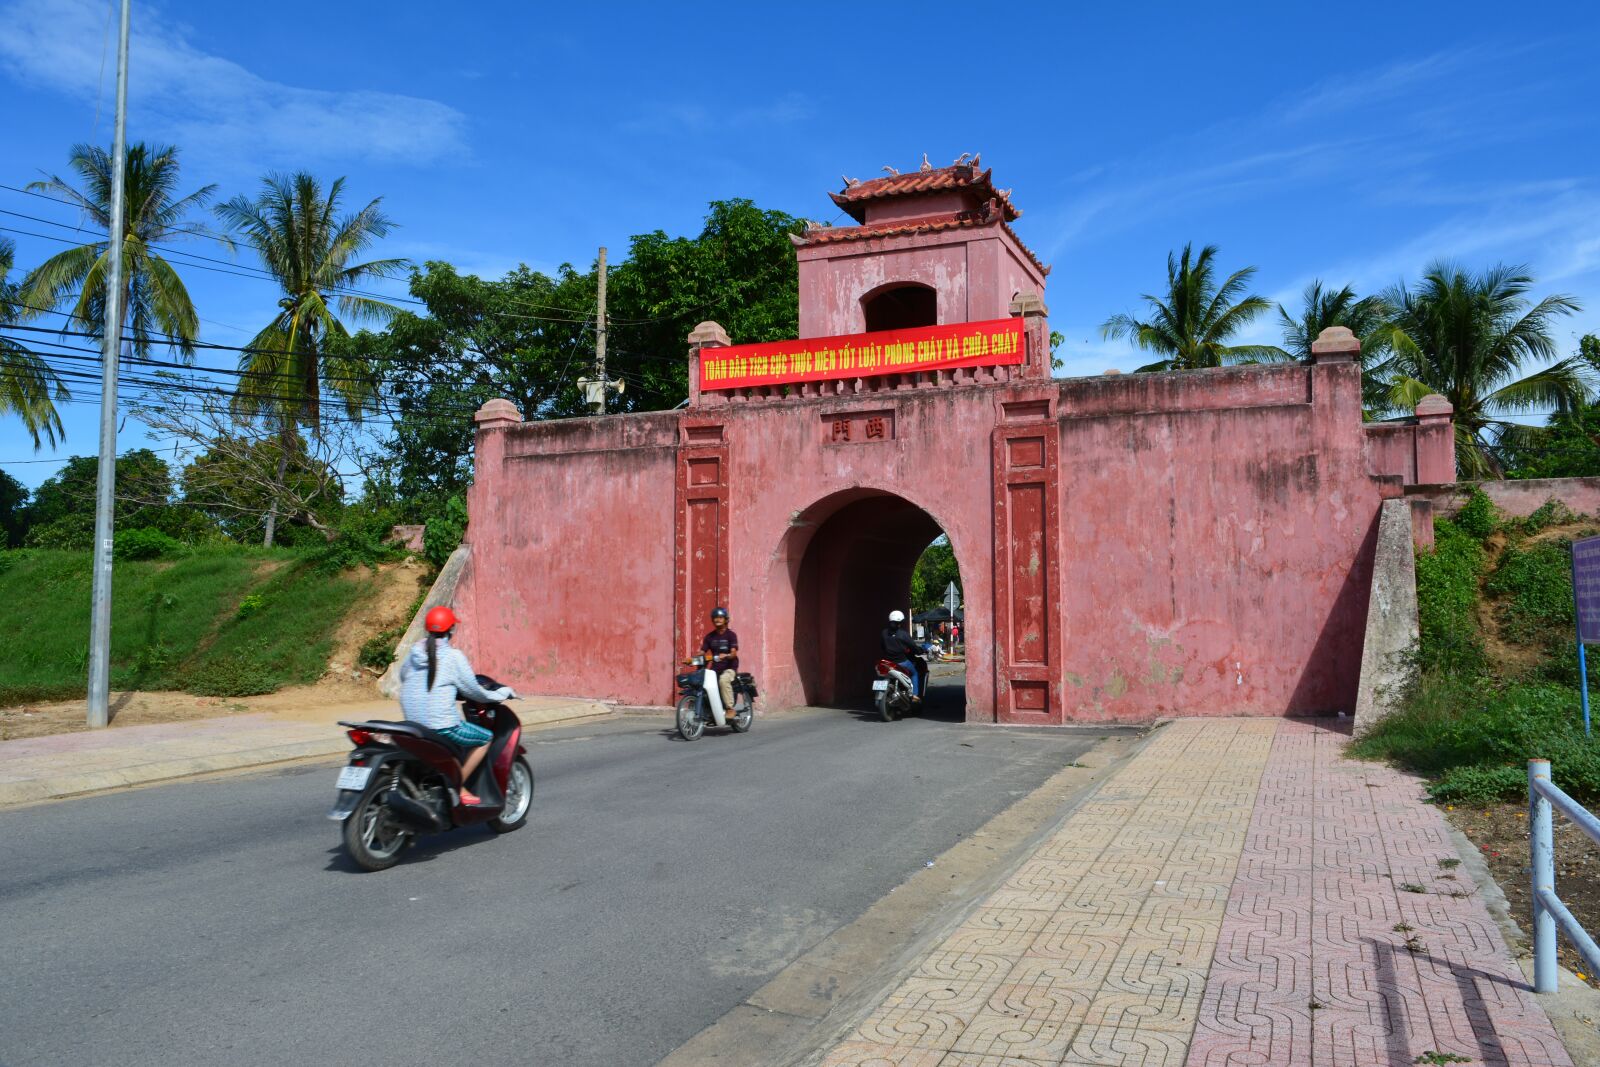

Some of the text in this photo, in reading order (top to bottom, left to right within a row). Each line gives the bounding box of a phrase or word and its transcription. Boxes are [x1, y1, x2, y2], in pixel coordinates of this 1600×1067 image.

[704, 328, 1018, 380] TOÀN DÂN TÍCH CỰC THỰC HIỆN TỐT LUẬT PHÒNG CHÁY VÀ CHỮA CHÁY
